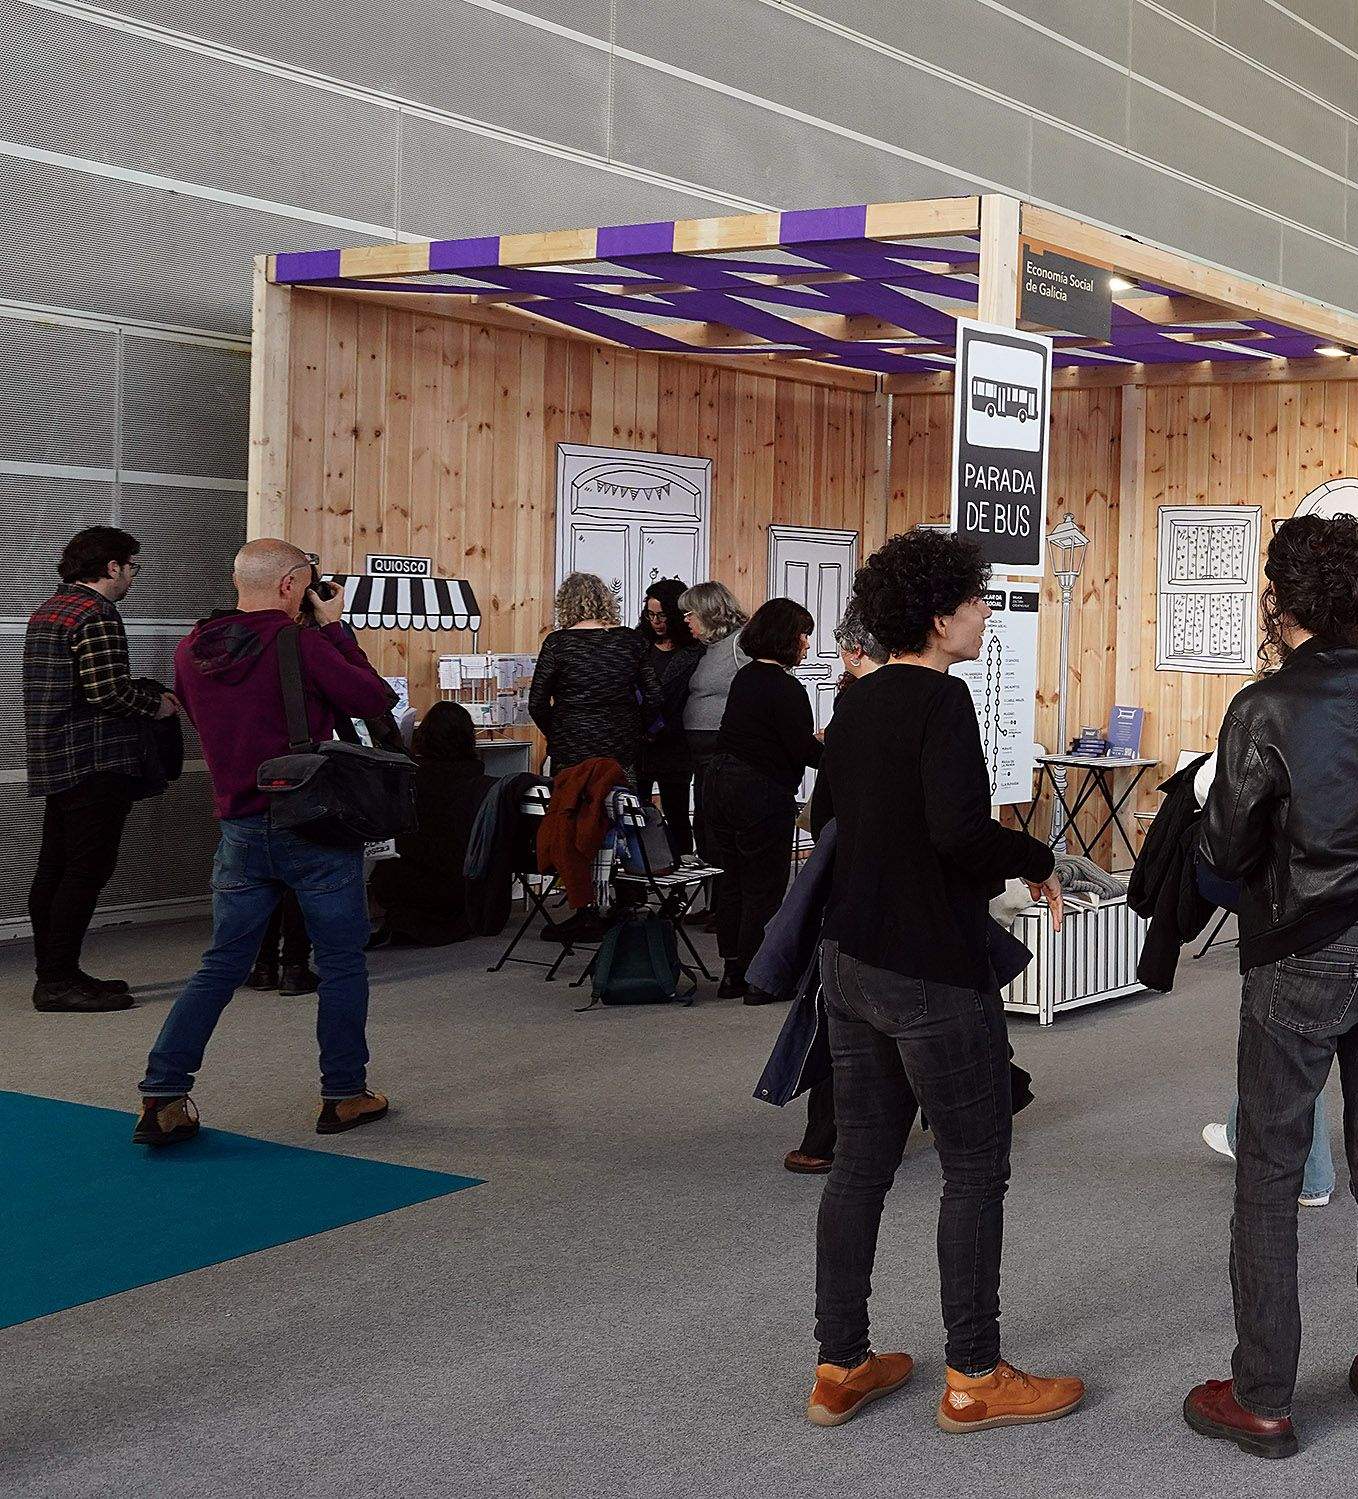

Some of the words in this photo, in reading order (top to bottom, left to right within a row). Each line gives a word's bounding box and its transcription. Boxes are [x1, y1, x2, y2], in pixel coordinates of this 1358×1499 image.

[1025, 279, 1038, 293] de
[1039, 282, 1068, 302] Galicia
[1026, 260, 1068, 285] Economía
[1069, 274, 1094, 292] Social
[965, 463, 1036, 495] PARADA
[966, 501, 990, 533] DE
[994, 503, 1030, 537] BUS
[374, 560, 426, 573] QUIOSCO
